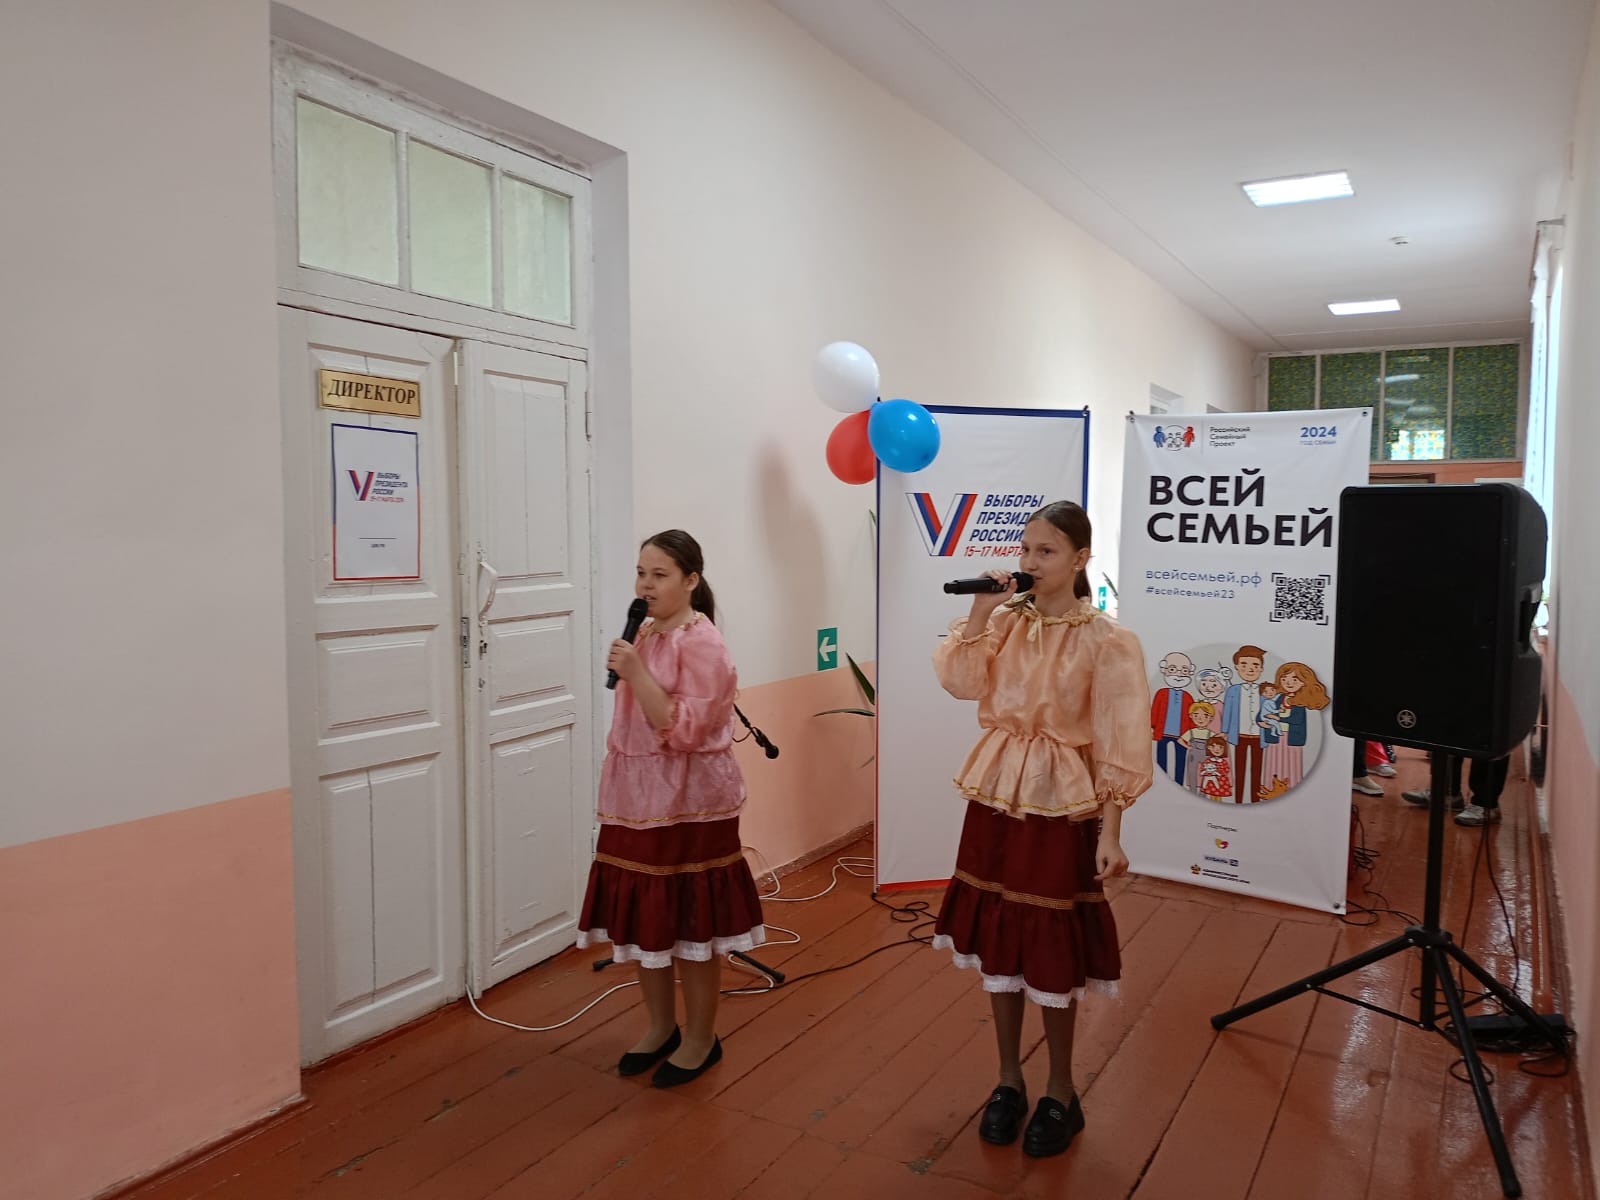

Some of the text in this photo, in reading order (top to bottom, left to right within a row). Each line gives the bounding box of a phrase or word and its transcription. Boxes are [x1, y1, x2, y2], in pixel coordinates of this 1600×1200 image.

[327, 379, 416, 404] ДИРЕКТОР
[1300, 426, 1337, 438] 2024
[1149, 468, 1265, 507] ВСЕЙ
[983, 494, 1045, 508] ВЫБОРЫ
[976, 511, 1032, 526] ПРЕЗИД
[1147, 507, 1333, 548] СЕМЬЕЙ
[969, 529, 1025, 542] РОССИИ
[1145, 569, 1262, 588] всейсемьей.рф
[1145, 586, 1235, 599] #всейсемьей23
